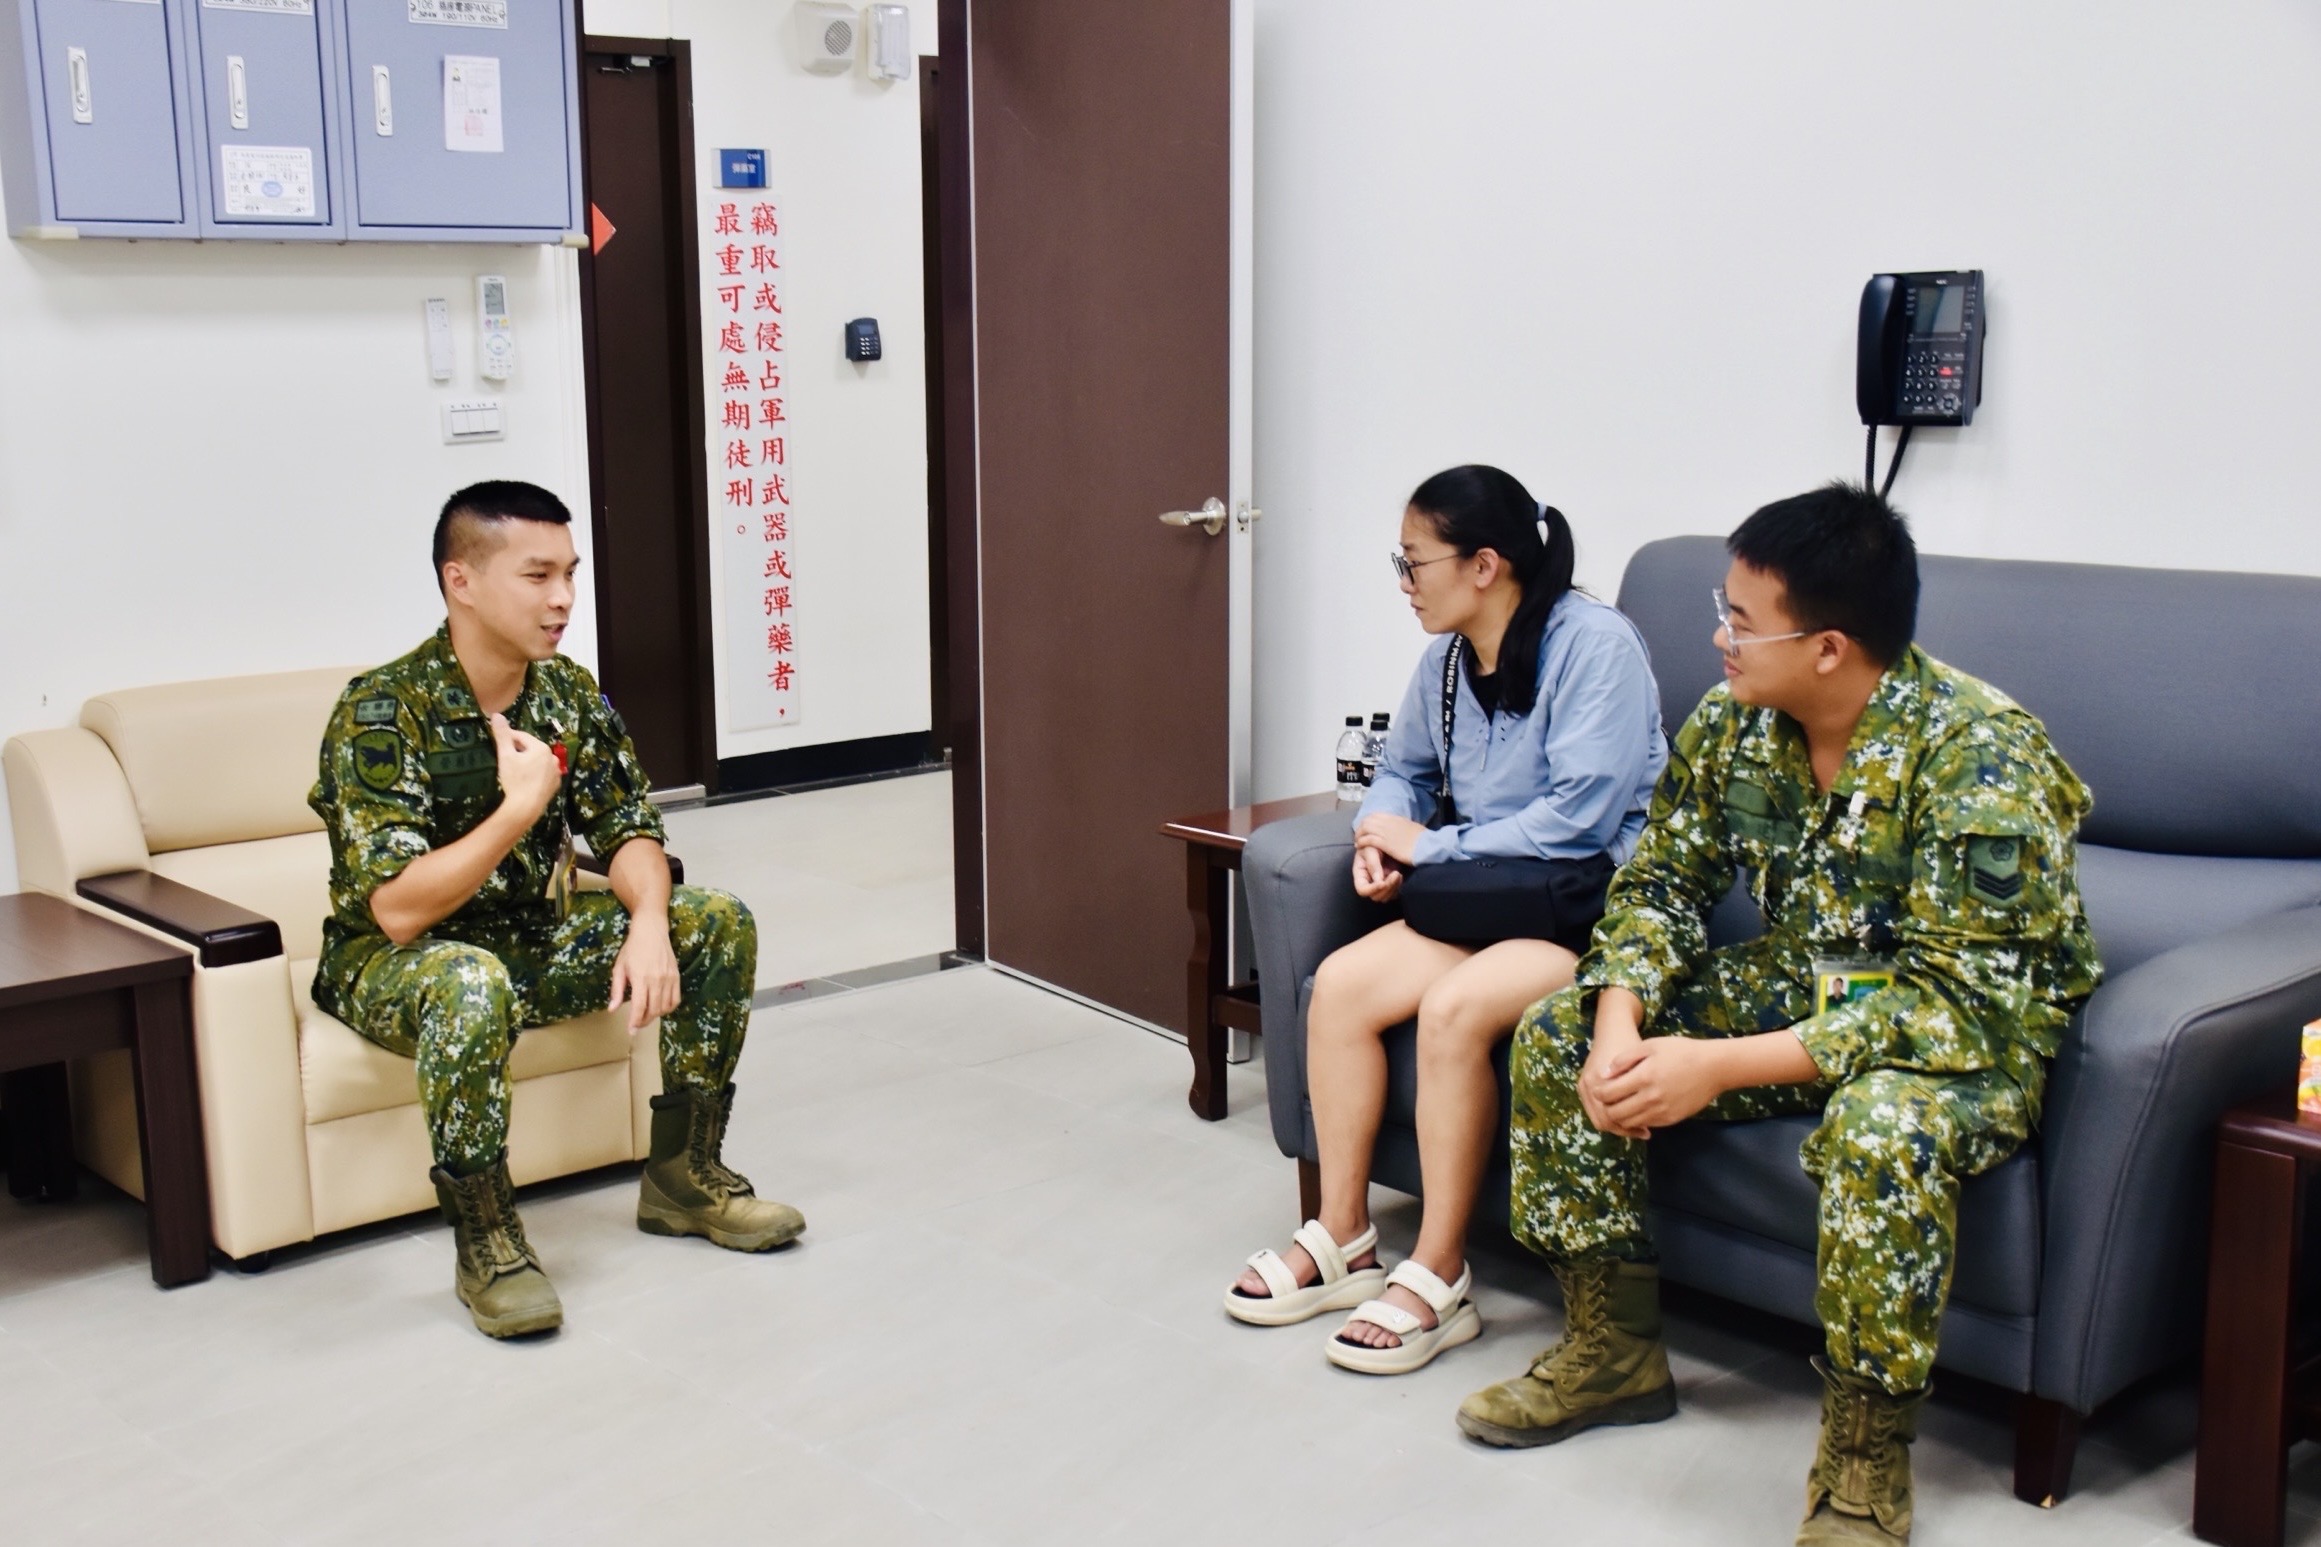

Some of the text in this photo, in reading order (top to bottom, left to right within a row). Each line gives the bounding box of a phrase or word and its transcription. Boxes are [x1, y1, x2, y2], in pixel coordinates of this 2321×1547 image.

[715, 202, 754, 535] 最重可處無期徒刑。
